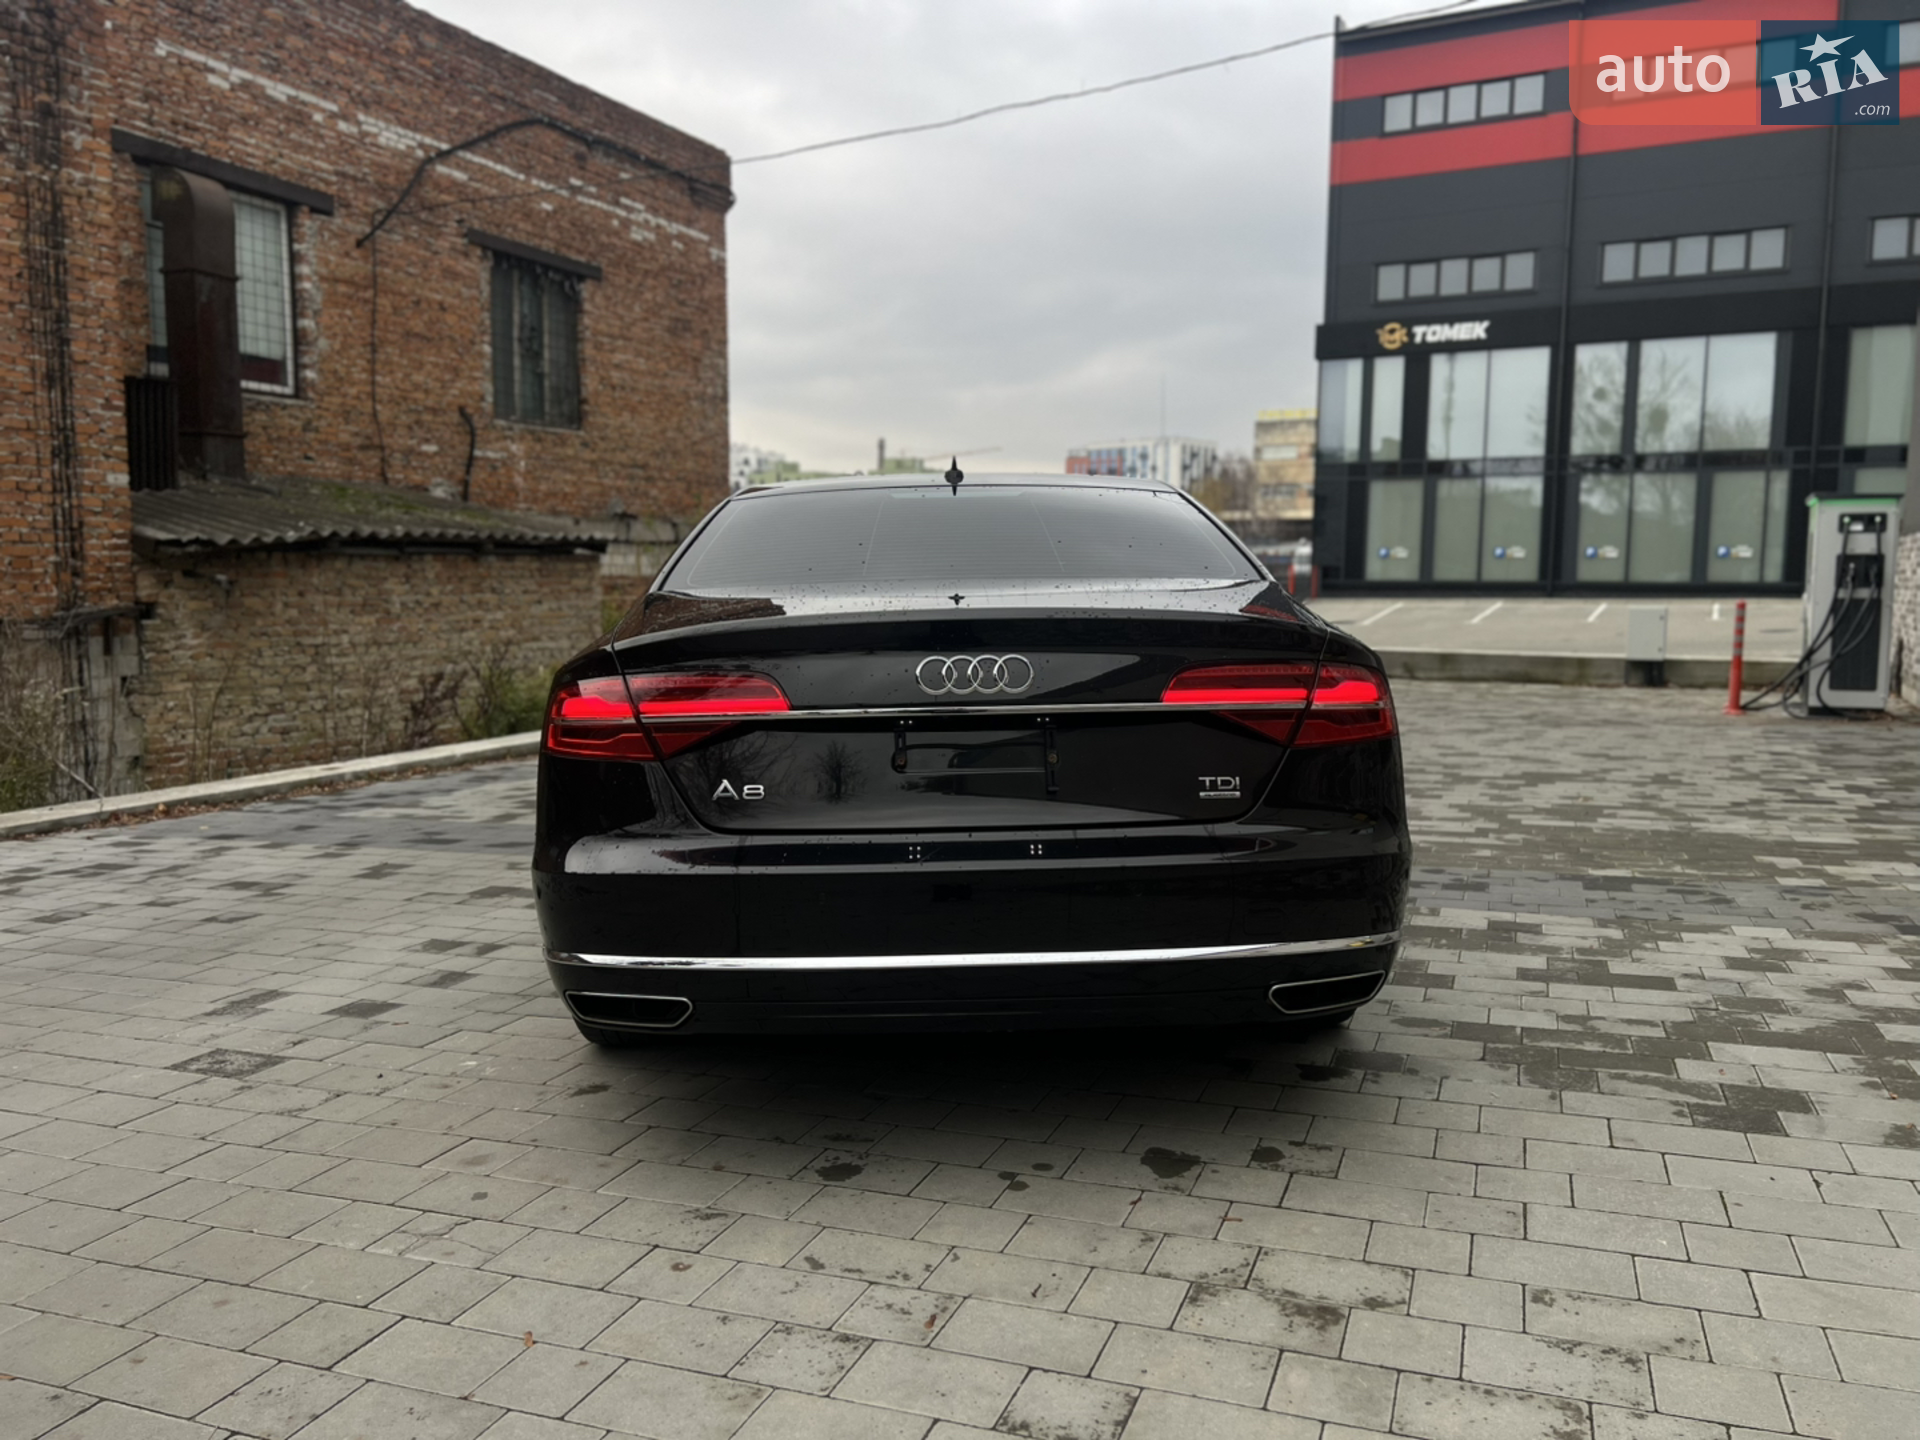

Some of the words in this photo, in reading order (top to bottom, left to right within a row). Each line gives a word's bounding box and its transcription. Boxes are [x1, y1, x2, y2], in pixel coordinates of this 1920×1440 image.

[1411, 320, 1491, 344] TOMEK
[712, 779, 765, 801] A8
[1198, 776, 1240, 790] TDI
